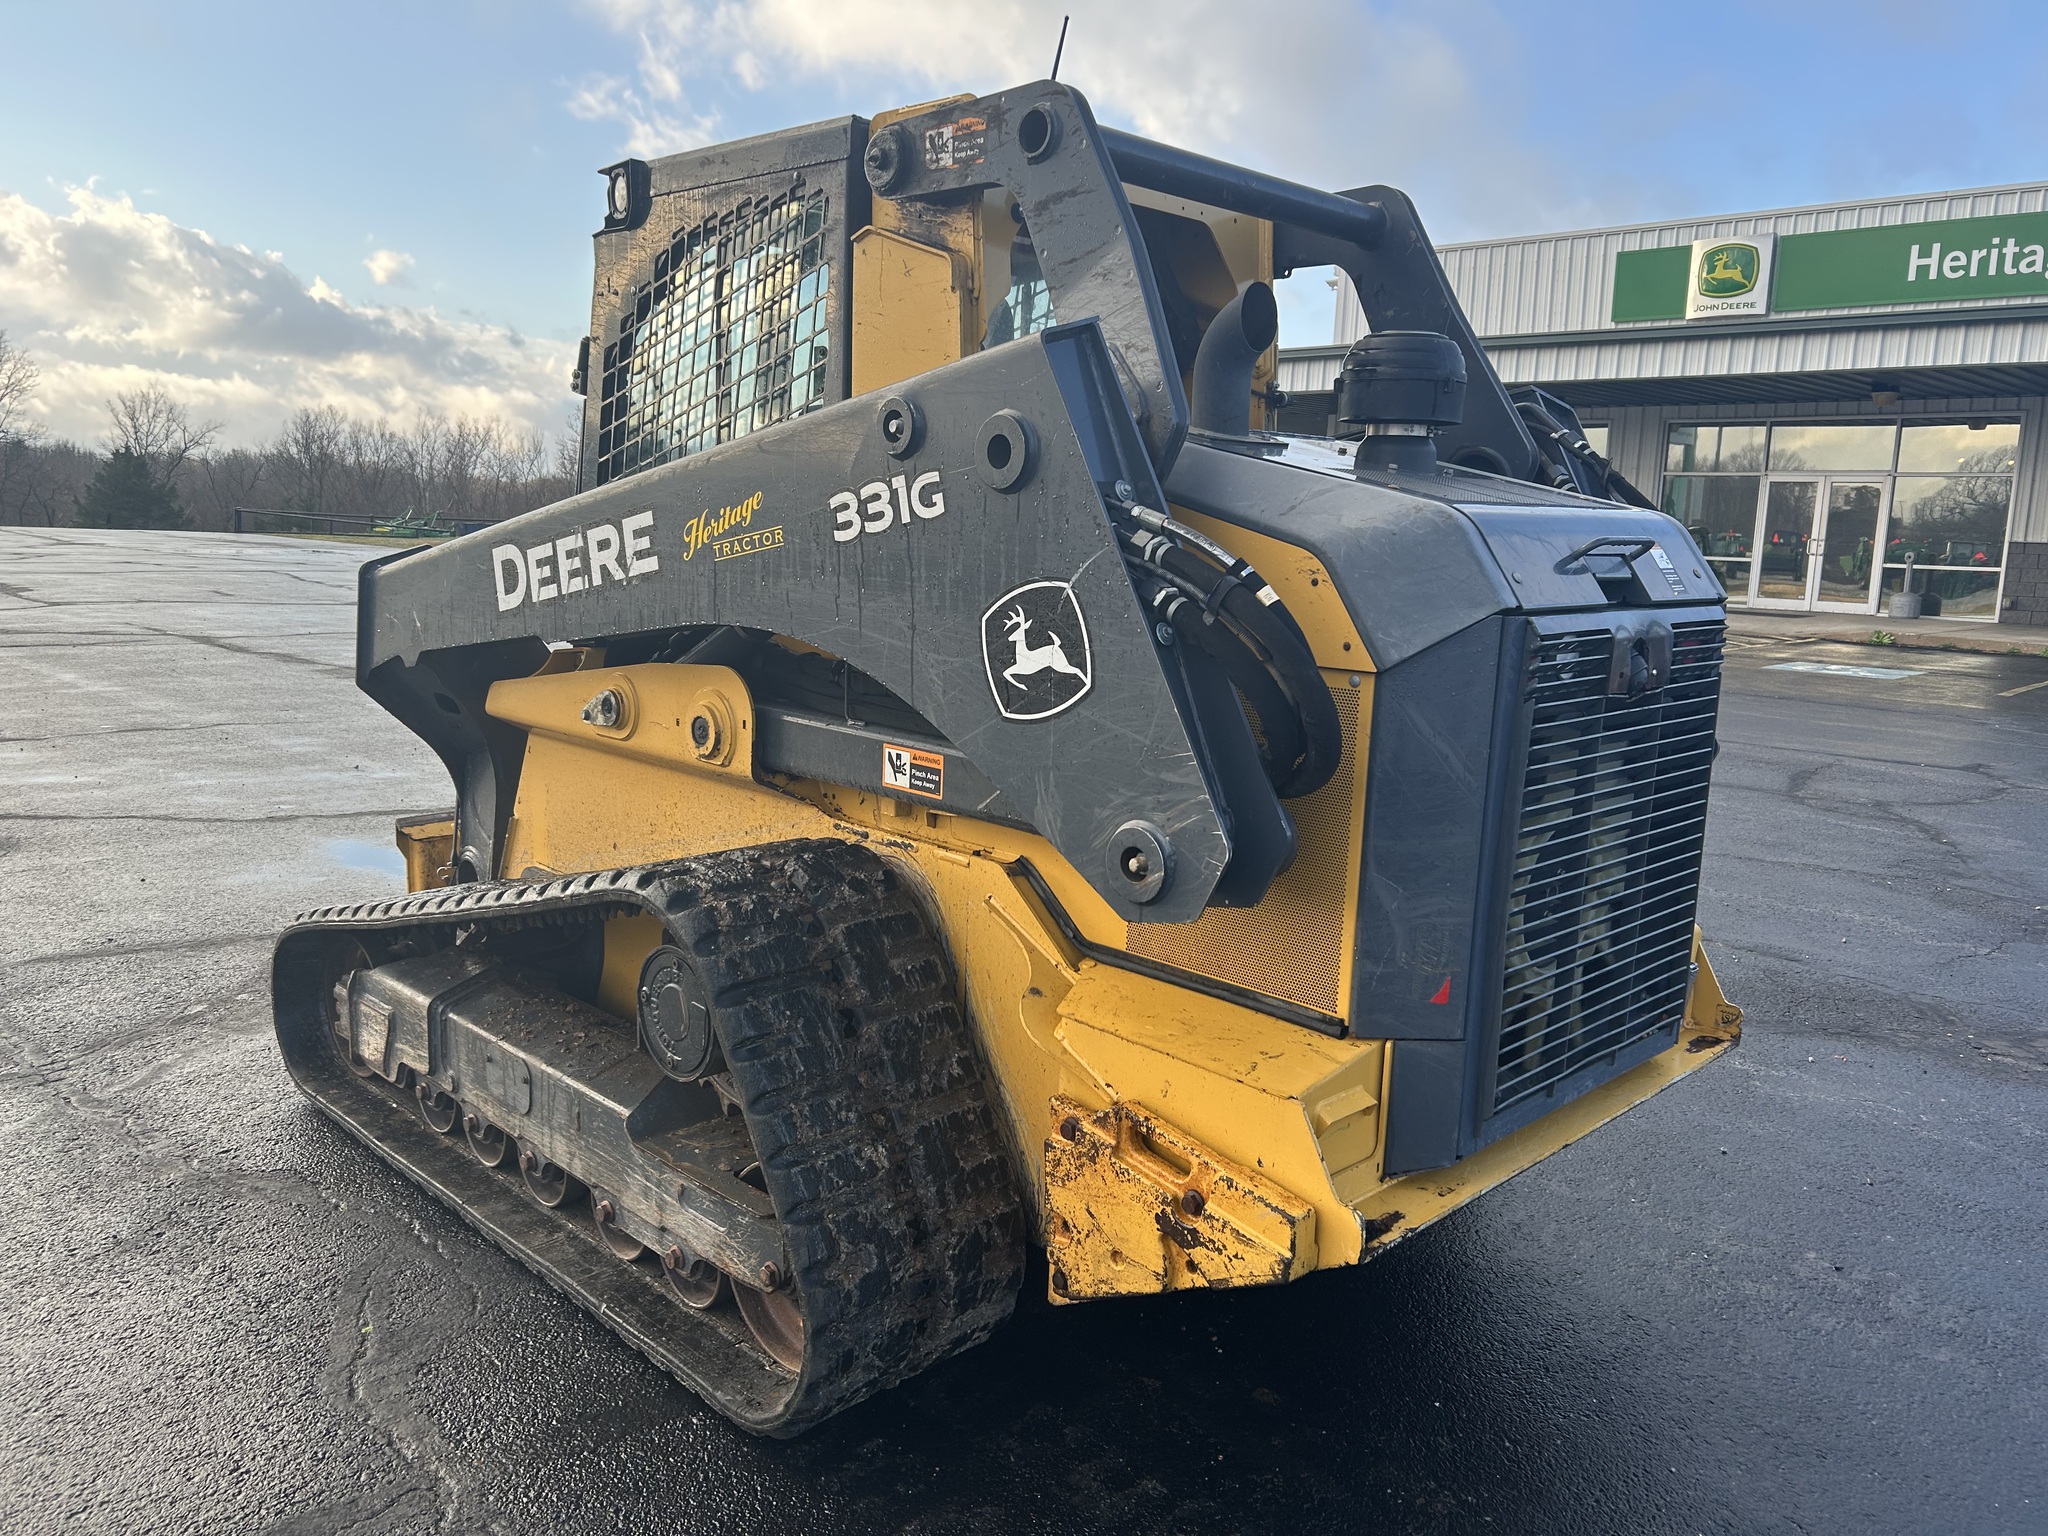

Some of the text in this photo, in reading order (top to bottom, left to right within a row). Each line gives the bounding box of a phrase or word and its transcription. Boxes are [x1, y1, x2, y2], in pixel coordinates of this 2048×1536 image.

[1907, 237, 2048, 281] Herita
[1693, 301, 1757, 313] JOHN DEERE
[827, 471, 946, 543] 331G
[683, 490, 764, 562] Heritage
[713, 529, 785, 558] TRACTOR
[491, 510, 659, 612] DEERE
[911, 769, 940, 782] Pinch Area
[917, 756, 941, 766] WARNING
[911, 778, 936, 790] Keep Away
